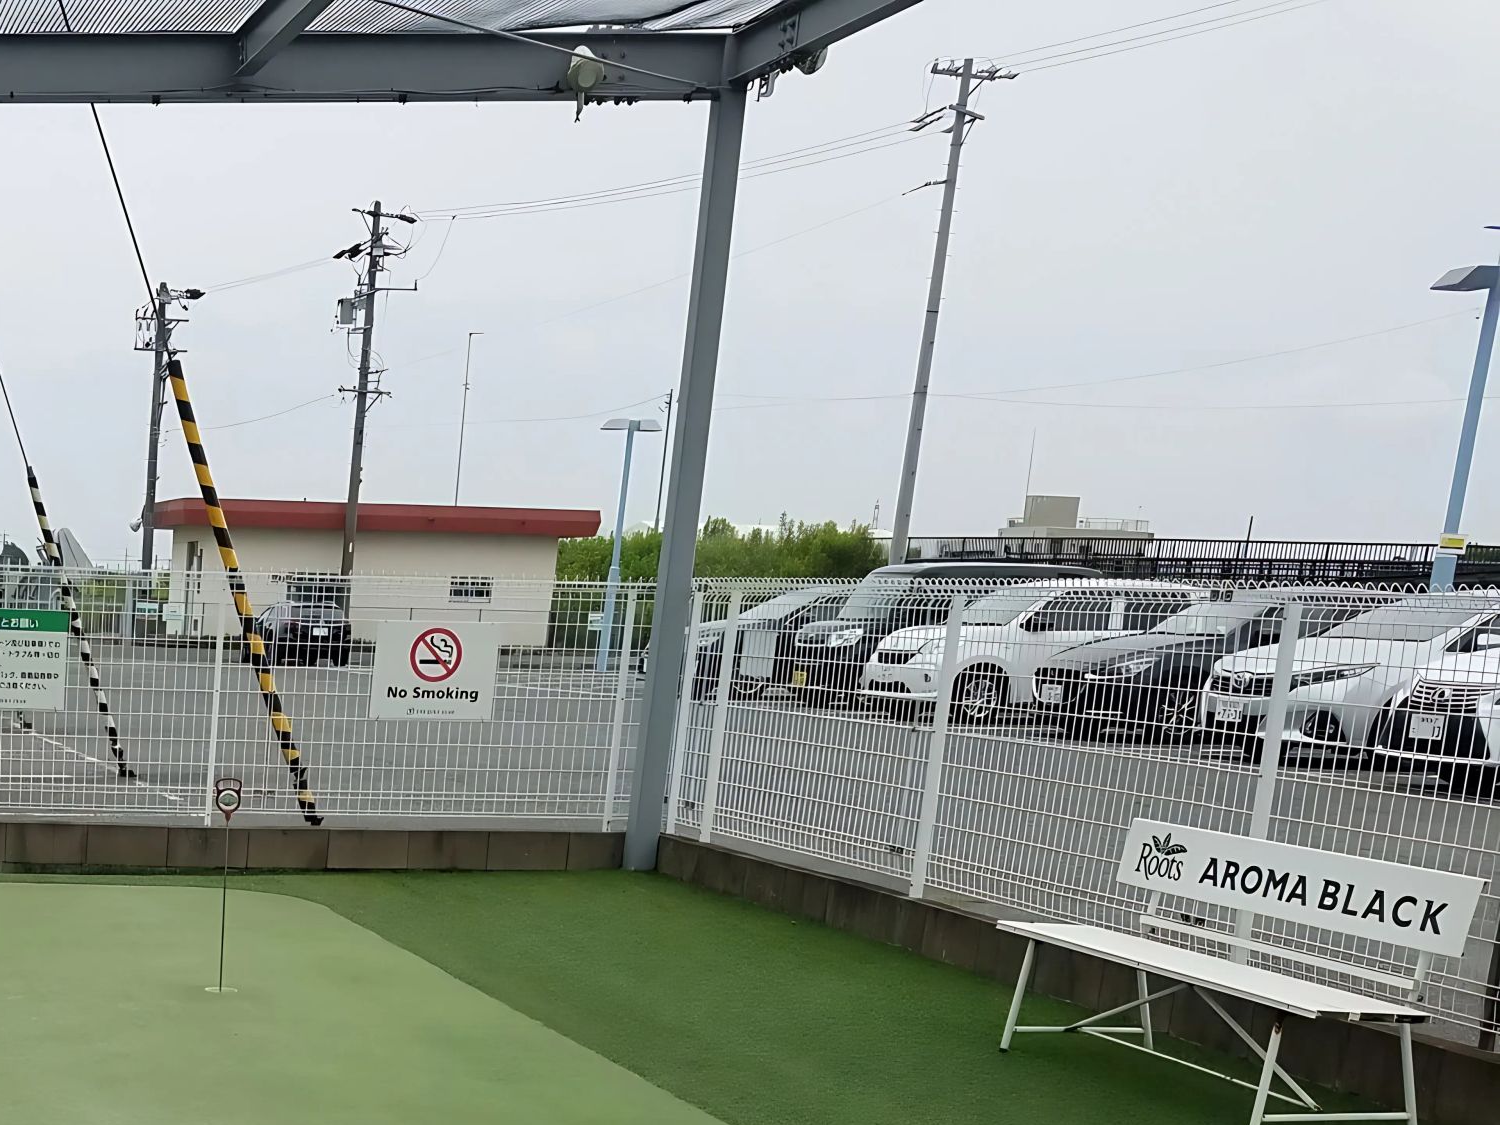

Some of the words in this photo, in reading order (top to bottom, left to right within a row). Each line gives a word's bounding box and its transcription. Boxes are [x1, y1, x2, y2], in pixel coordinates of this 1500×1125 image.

[387, 686, 407, 698] No
[413, 686, 479, 702] Smoking
[1135, 842, 1184, 881] Roots
[1198, 857, 1308, 907] AROMA
[1318, 879, 1448, 935] BLACK
